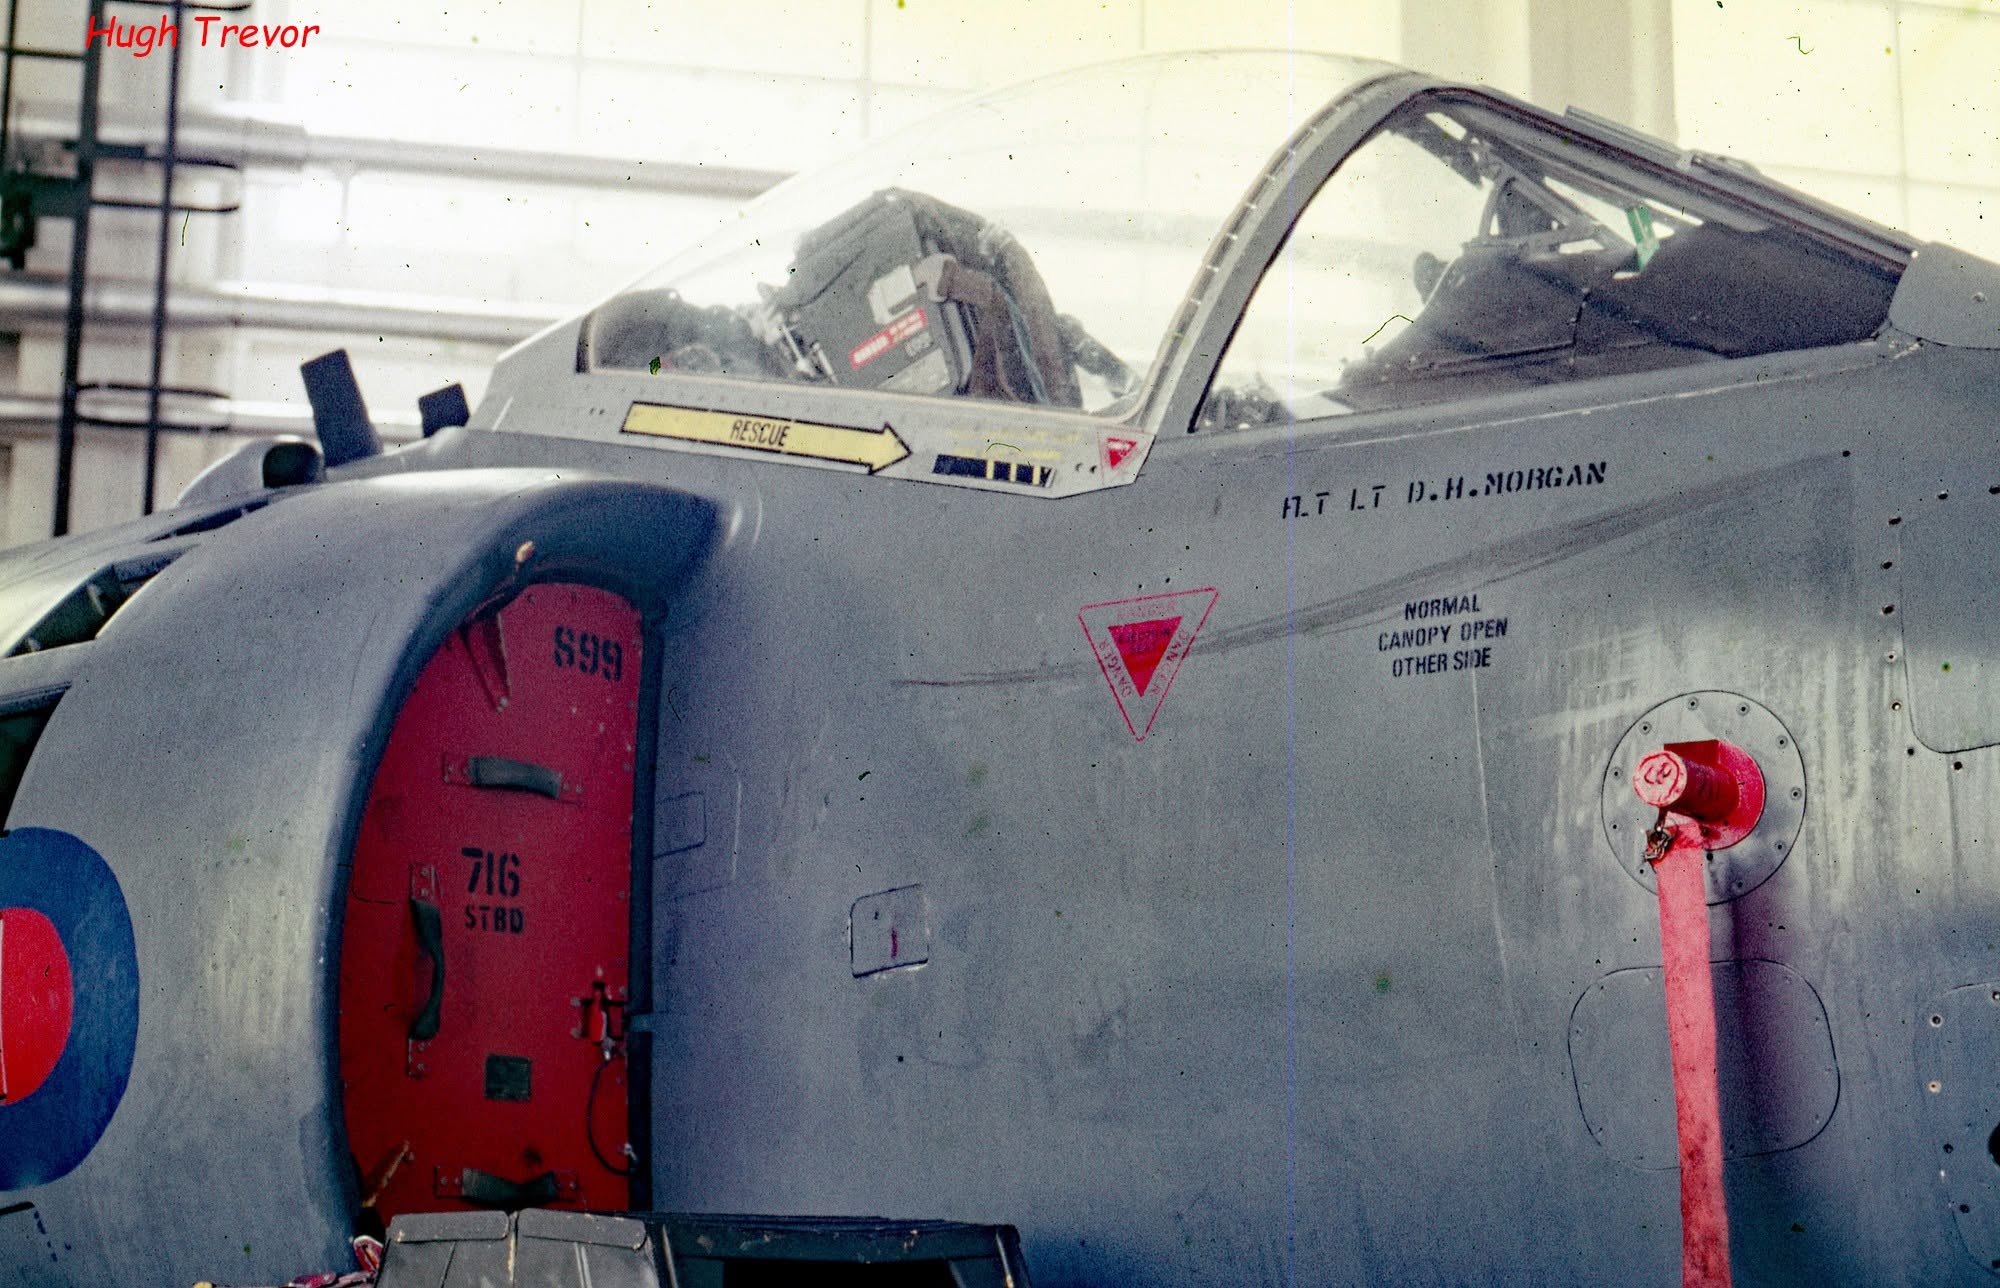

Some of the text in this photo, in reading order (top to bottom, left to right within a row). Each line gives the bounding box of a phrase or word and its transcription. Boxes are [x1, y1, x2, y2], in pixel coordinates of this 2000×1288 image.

[729, 419, 791, 447] RESCUE
[1350, 484, 1387, 511] LT
[1404, 593, 1481, 621] NORMAL
[1378, 617, 1509, 652] CANOPY OPEN
[554, 626, 622, 682] 899
[1392, 647, 1492, 678] OTHER SIDE
[461, 847, 520, 897] 716
[464, 904, 524, 934] STBD
